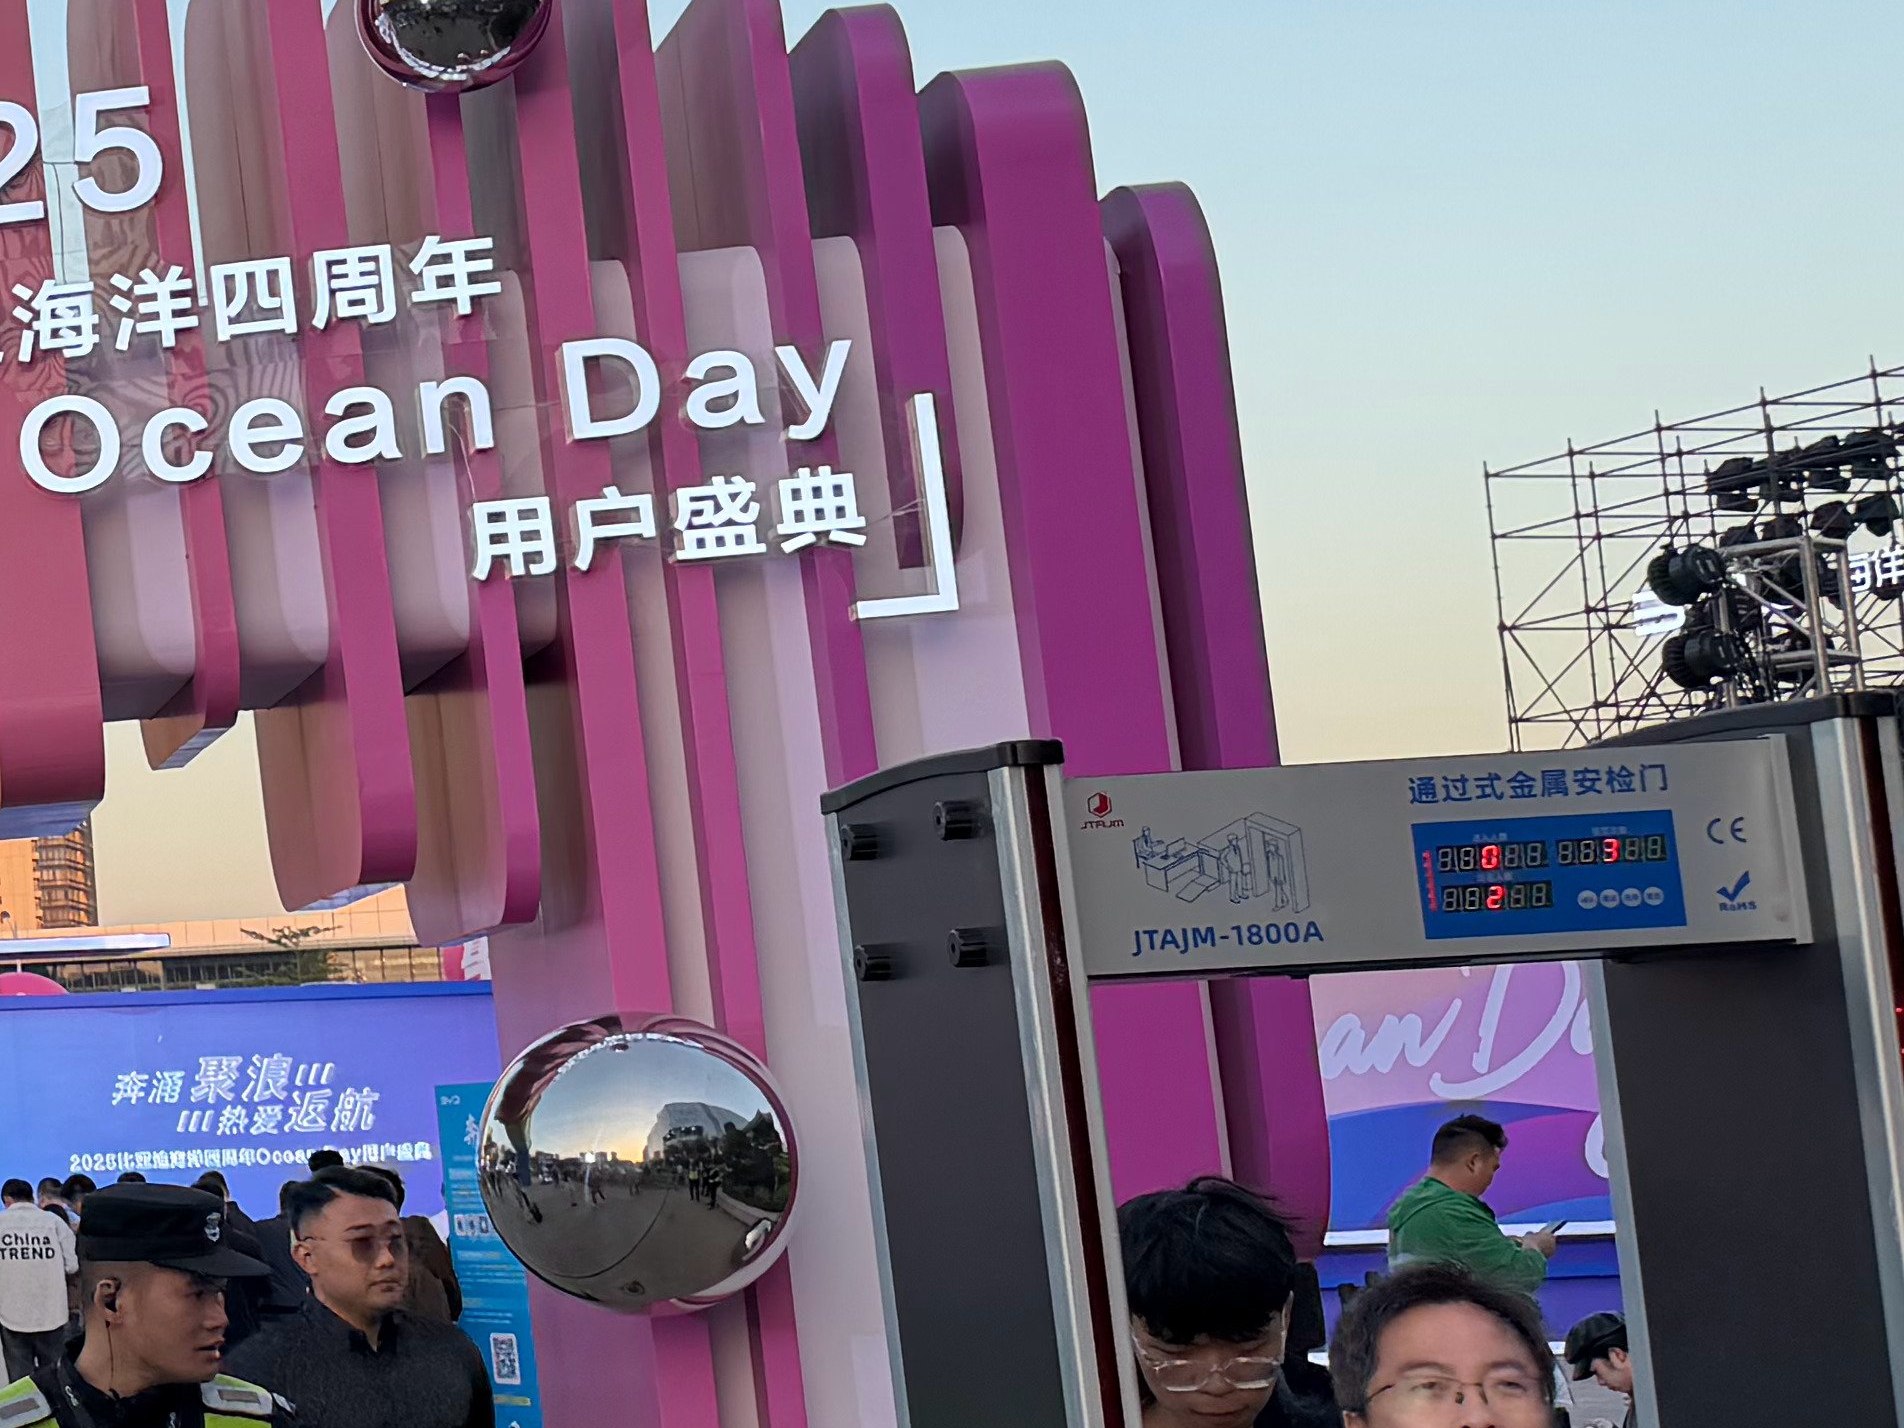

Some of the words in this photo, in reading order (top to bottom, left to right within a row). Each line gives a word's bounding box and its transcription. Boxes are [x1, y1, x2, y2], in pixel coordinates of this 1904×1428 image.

[19, 372, 496, 494] Ocean
[562, 338, 853, 443] Day
[470, 462, 868, 583] 用户盛典
[1408, 763, 1669, 805] 通过式金属安检门
[1131, 920, 1325, 957] JTAJM-1800A
[1, 1232, 51, 1247] China
